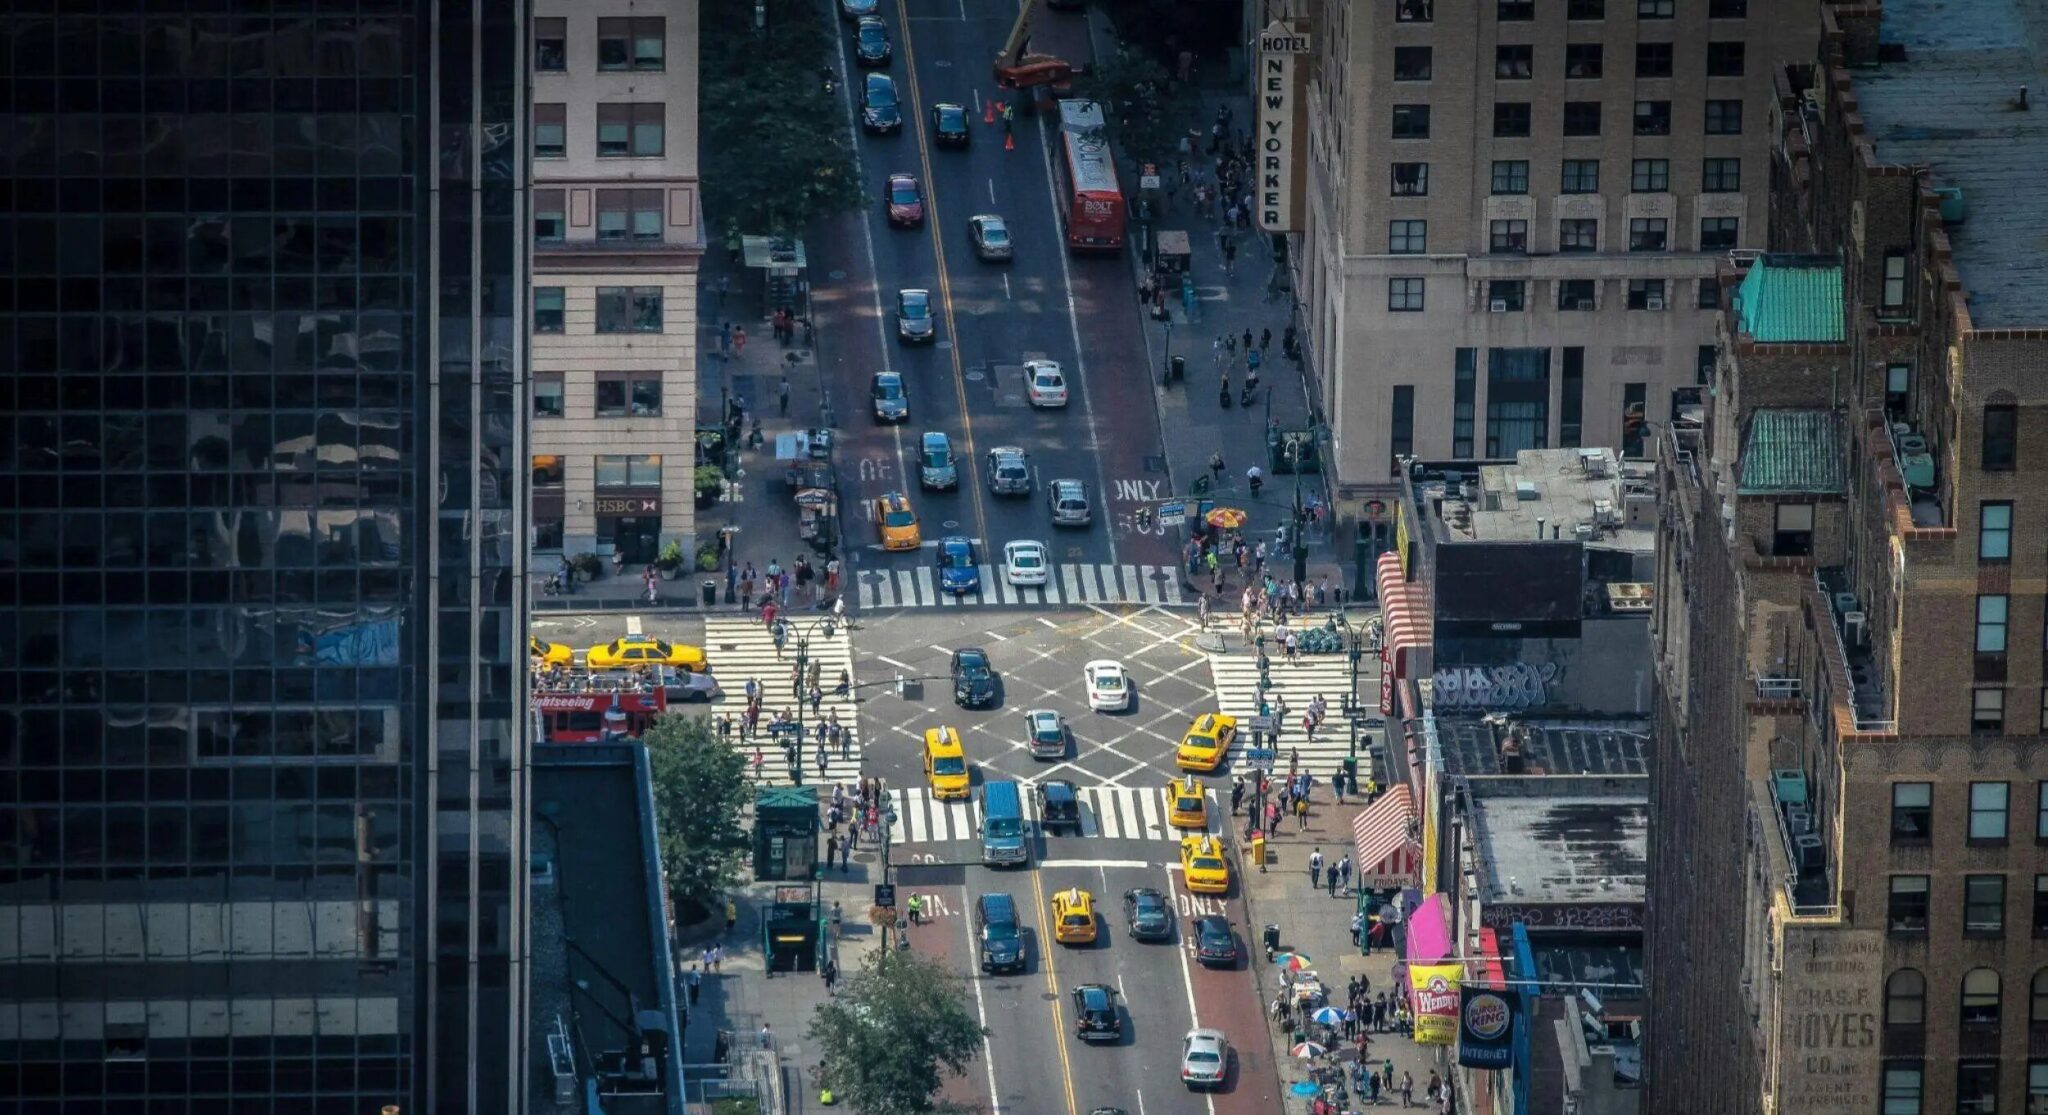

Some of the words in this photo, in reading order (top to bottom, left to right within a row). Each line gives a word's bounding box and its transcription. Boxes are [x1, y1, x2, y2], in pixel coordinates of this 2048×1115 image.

[1263, 37, 1309, 51] HOTEL
[1266, 59, 1283, 110] NEW
[1265, 121, 1282, 224] YORKER
[1085, 200, 1114, 210] BOLT
[597, 500, 637, 512] HSBC
[532, 696, 595, 710] ightseeing
[1180, 894, 1228, 917] ONLY
[1471, 1011, 1505, 1027] KING
[1462, 1045, 1508, 1060] INTERNET
[1804, 1082, 1853, 1093] AGENT
